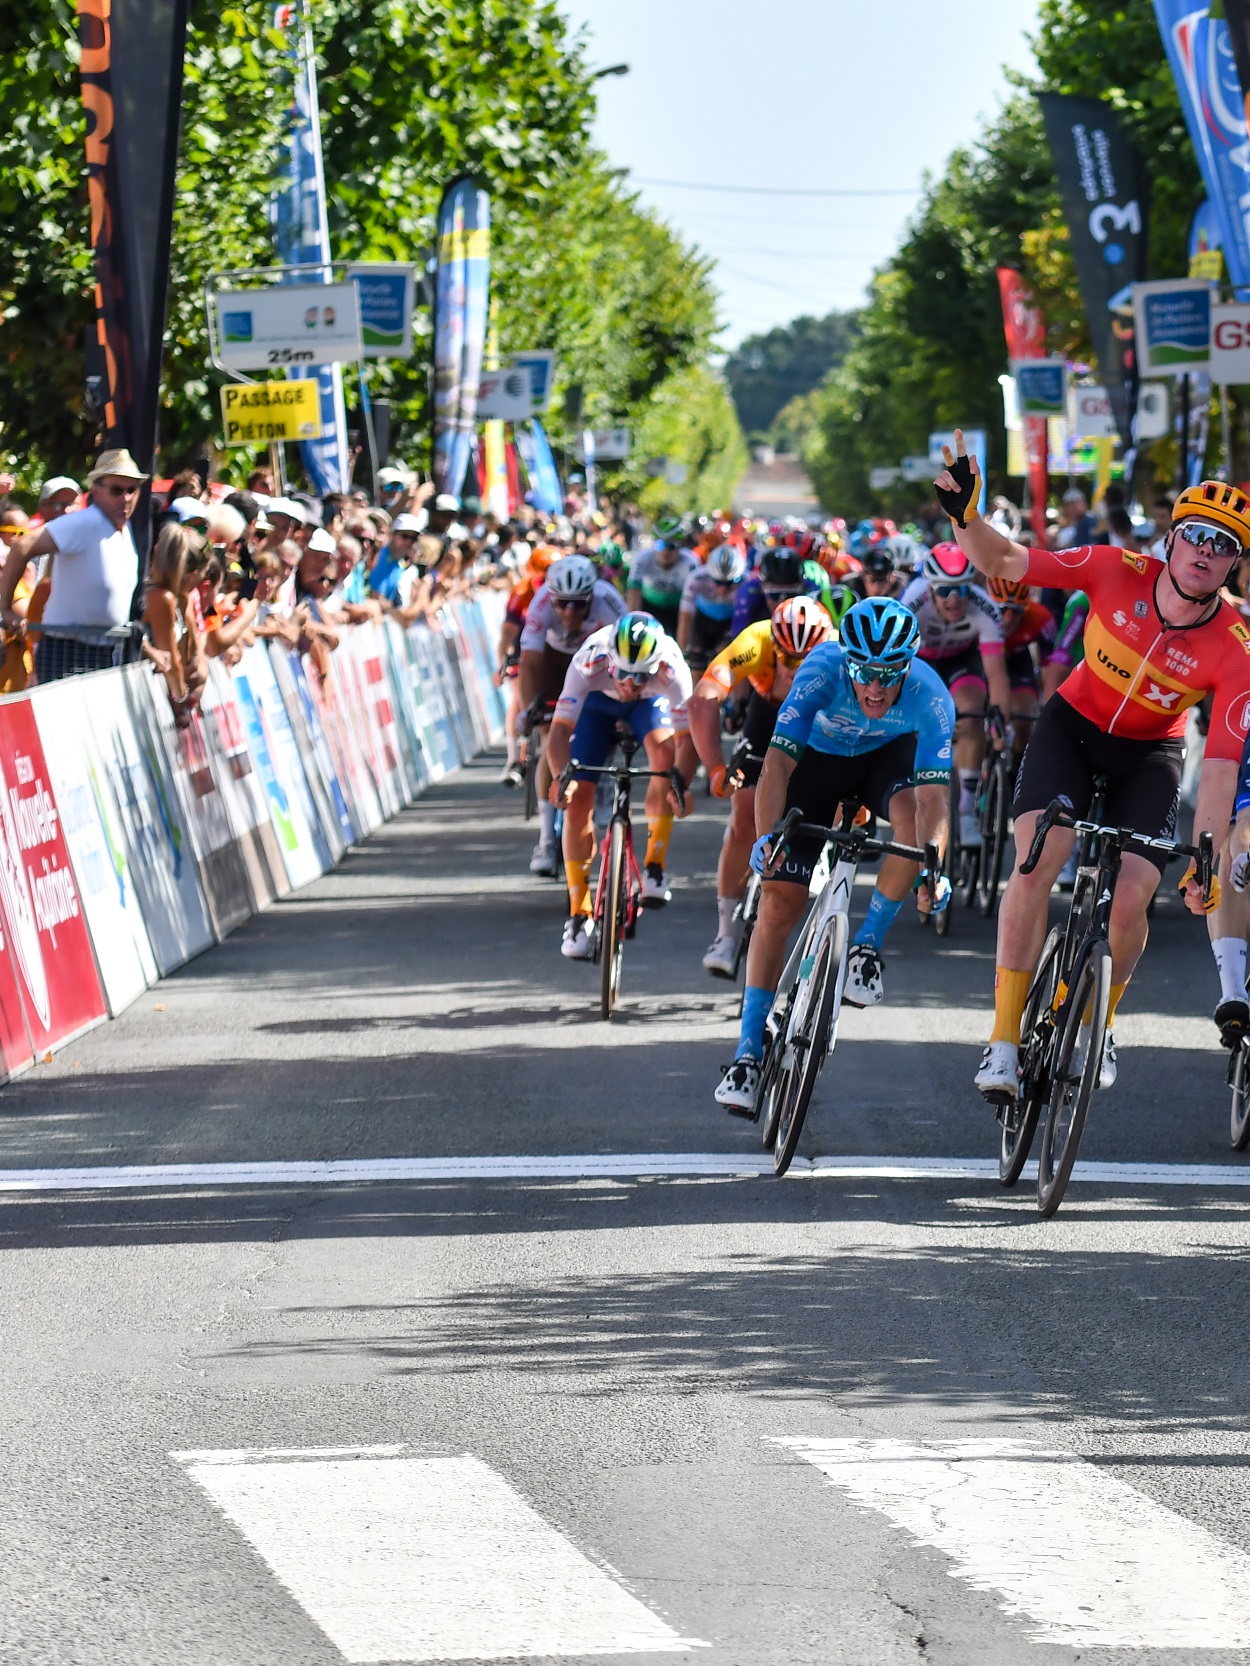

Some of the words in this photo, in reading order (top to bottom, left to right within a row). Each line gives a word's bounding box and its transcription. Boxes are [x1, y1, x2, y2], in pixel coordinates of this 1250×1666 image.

[268, 349, 314, 363] 25m
[228, 419, 286, 442] PIÉTON
[1097, 648, 1131, 679] Uno
[1165, 659, 1190, 676] 1000
[1166, 647, 1198, 669] REMA
